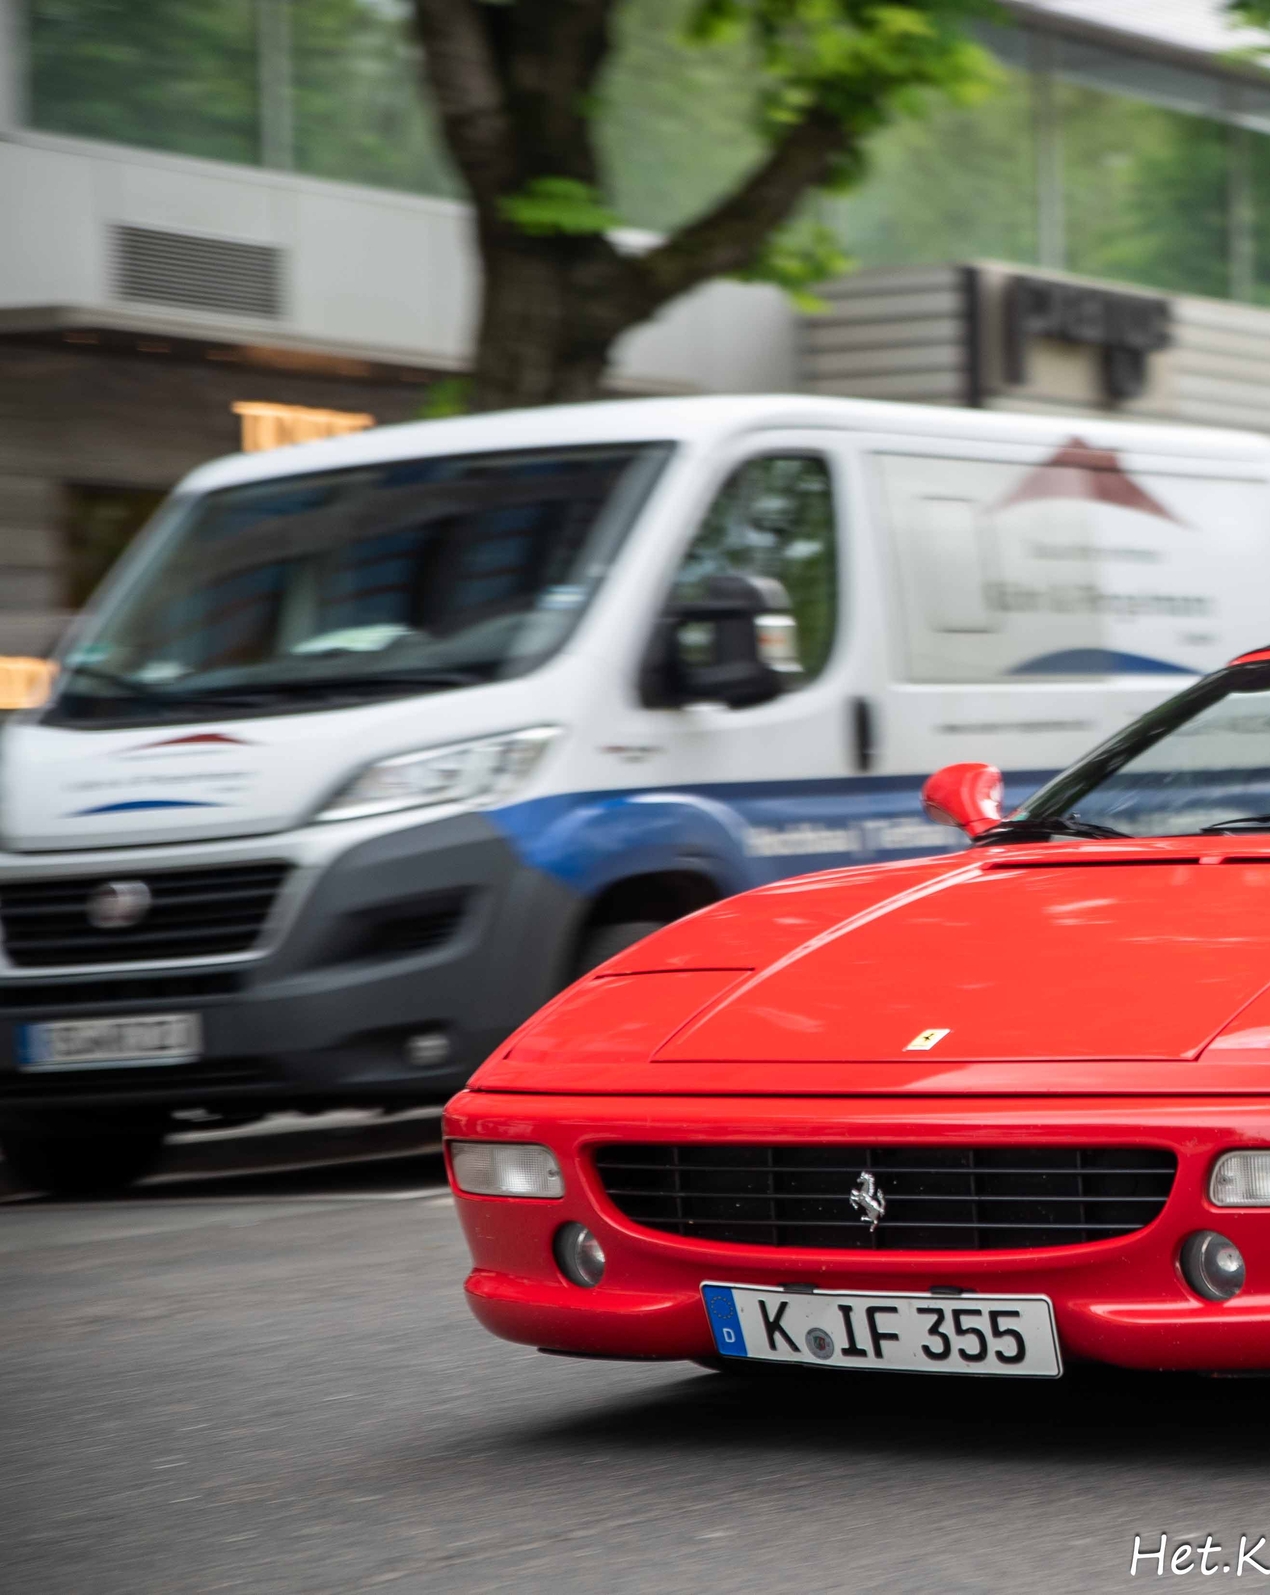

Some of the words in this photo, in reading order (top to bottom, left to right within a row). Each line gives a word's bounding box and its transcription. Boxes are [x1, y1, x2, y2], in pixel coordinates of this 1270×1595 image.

[722, 1327, 736, 1343] D
[758, 1299, 801, 1353] K
[837, 1304, 900, 1359] IF
[916, 1307, 1026, 1364] 355
